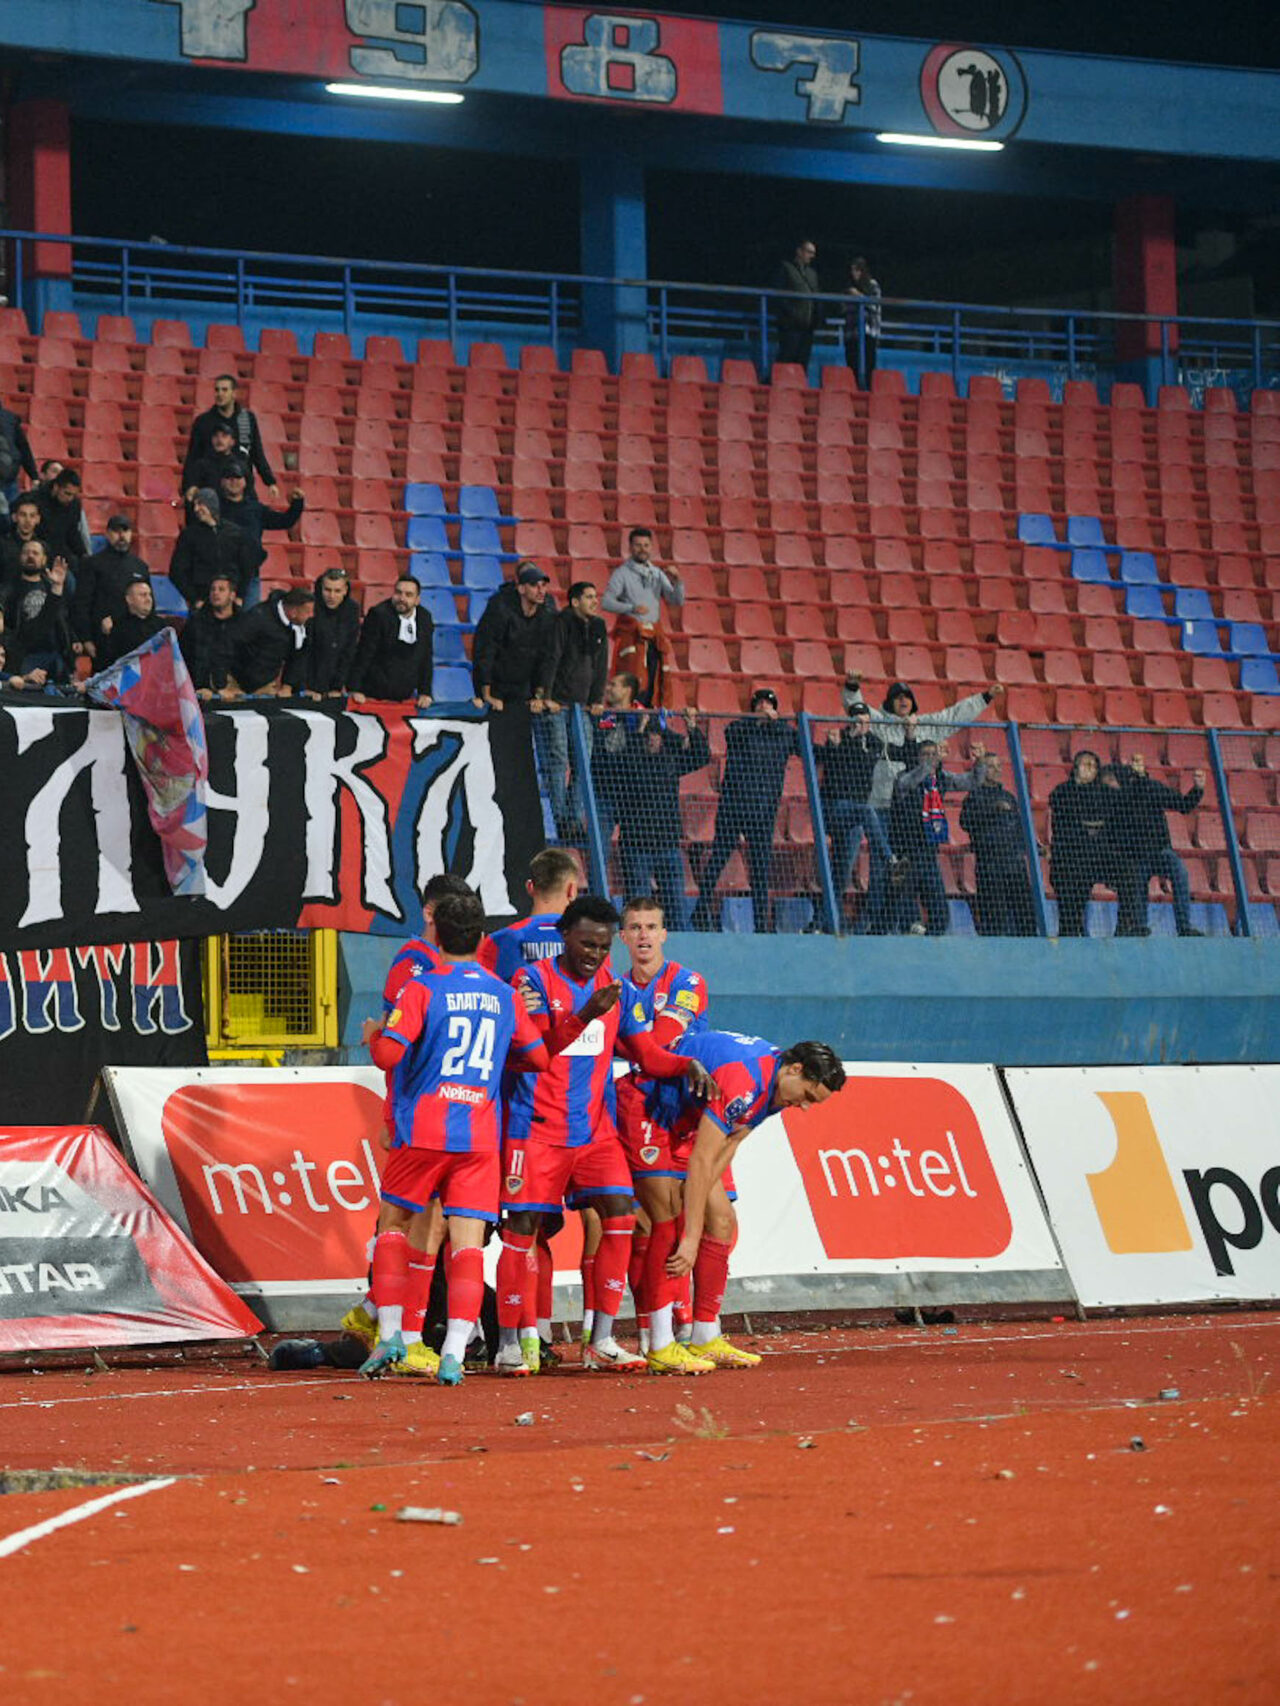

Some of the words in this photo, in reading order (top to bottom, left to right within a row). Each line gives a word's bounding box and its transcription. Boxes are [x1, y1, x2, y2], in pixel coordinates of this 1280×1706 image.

[3, 706, 518, 928] ЛУКА
[440, 1016, 496, 1081] 24
[438, 1085, 485, 1105] Nektar
[202, 1139, 382, 1215] m:tel
[510, 1149, 525, 1175] 11
[818, 1130, 977, 1198] m:tel
